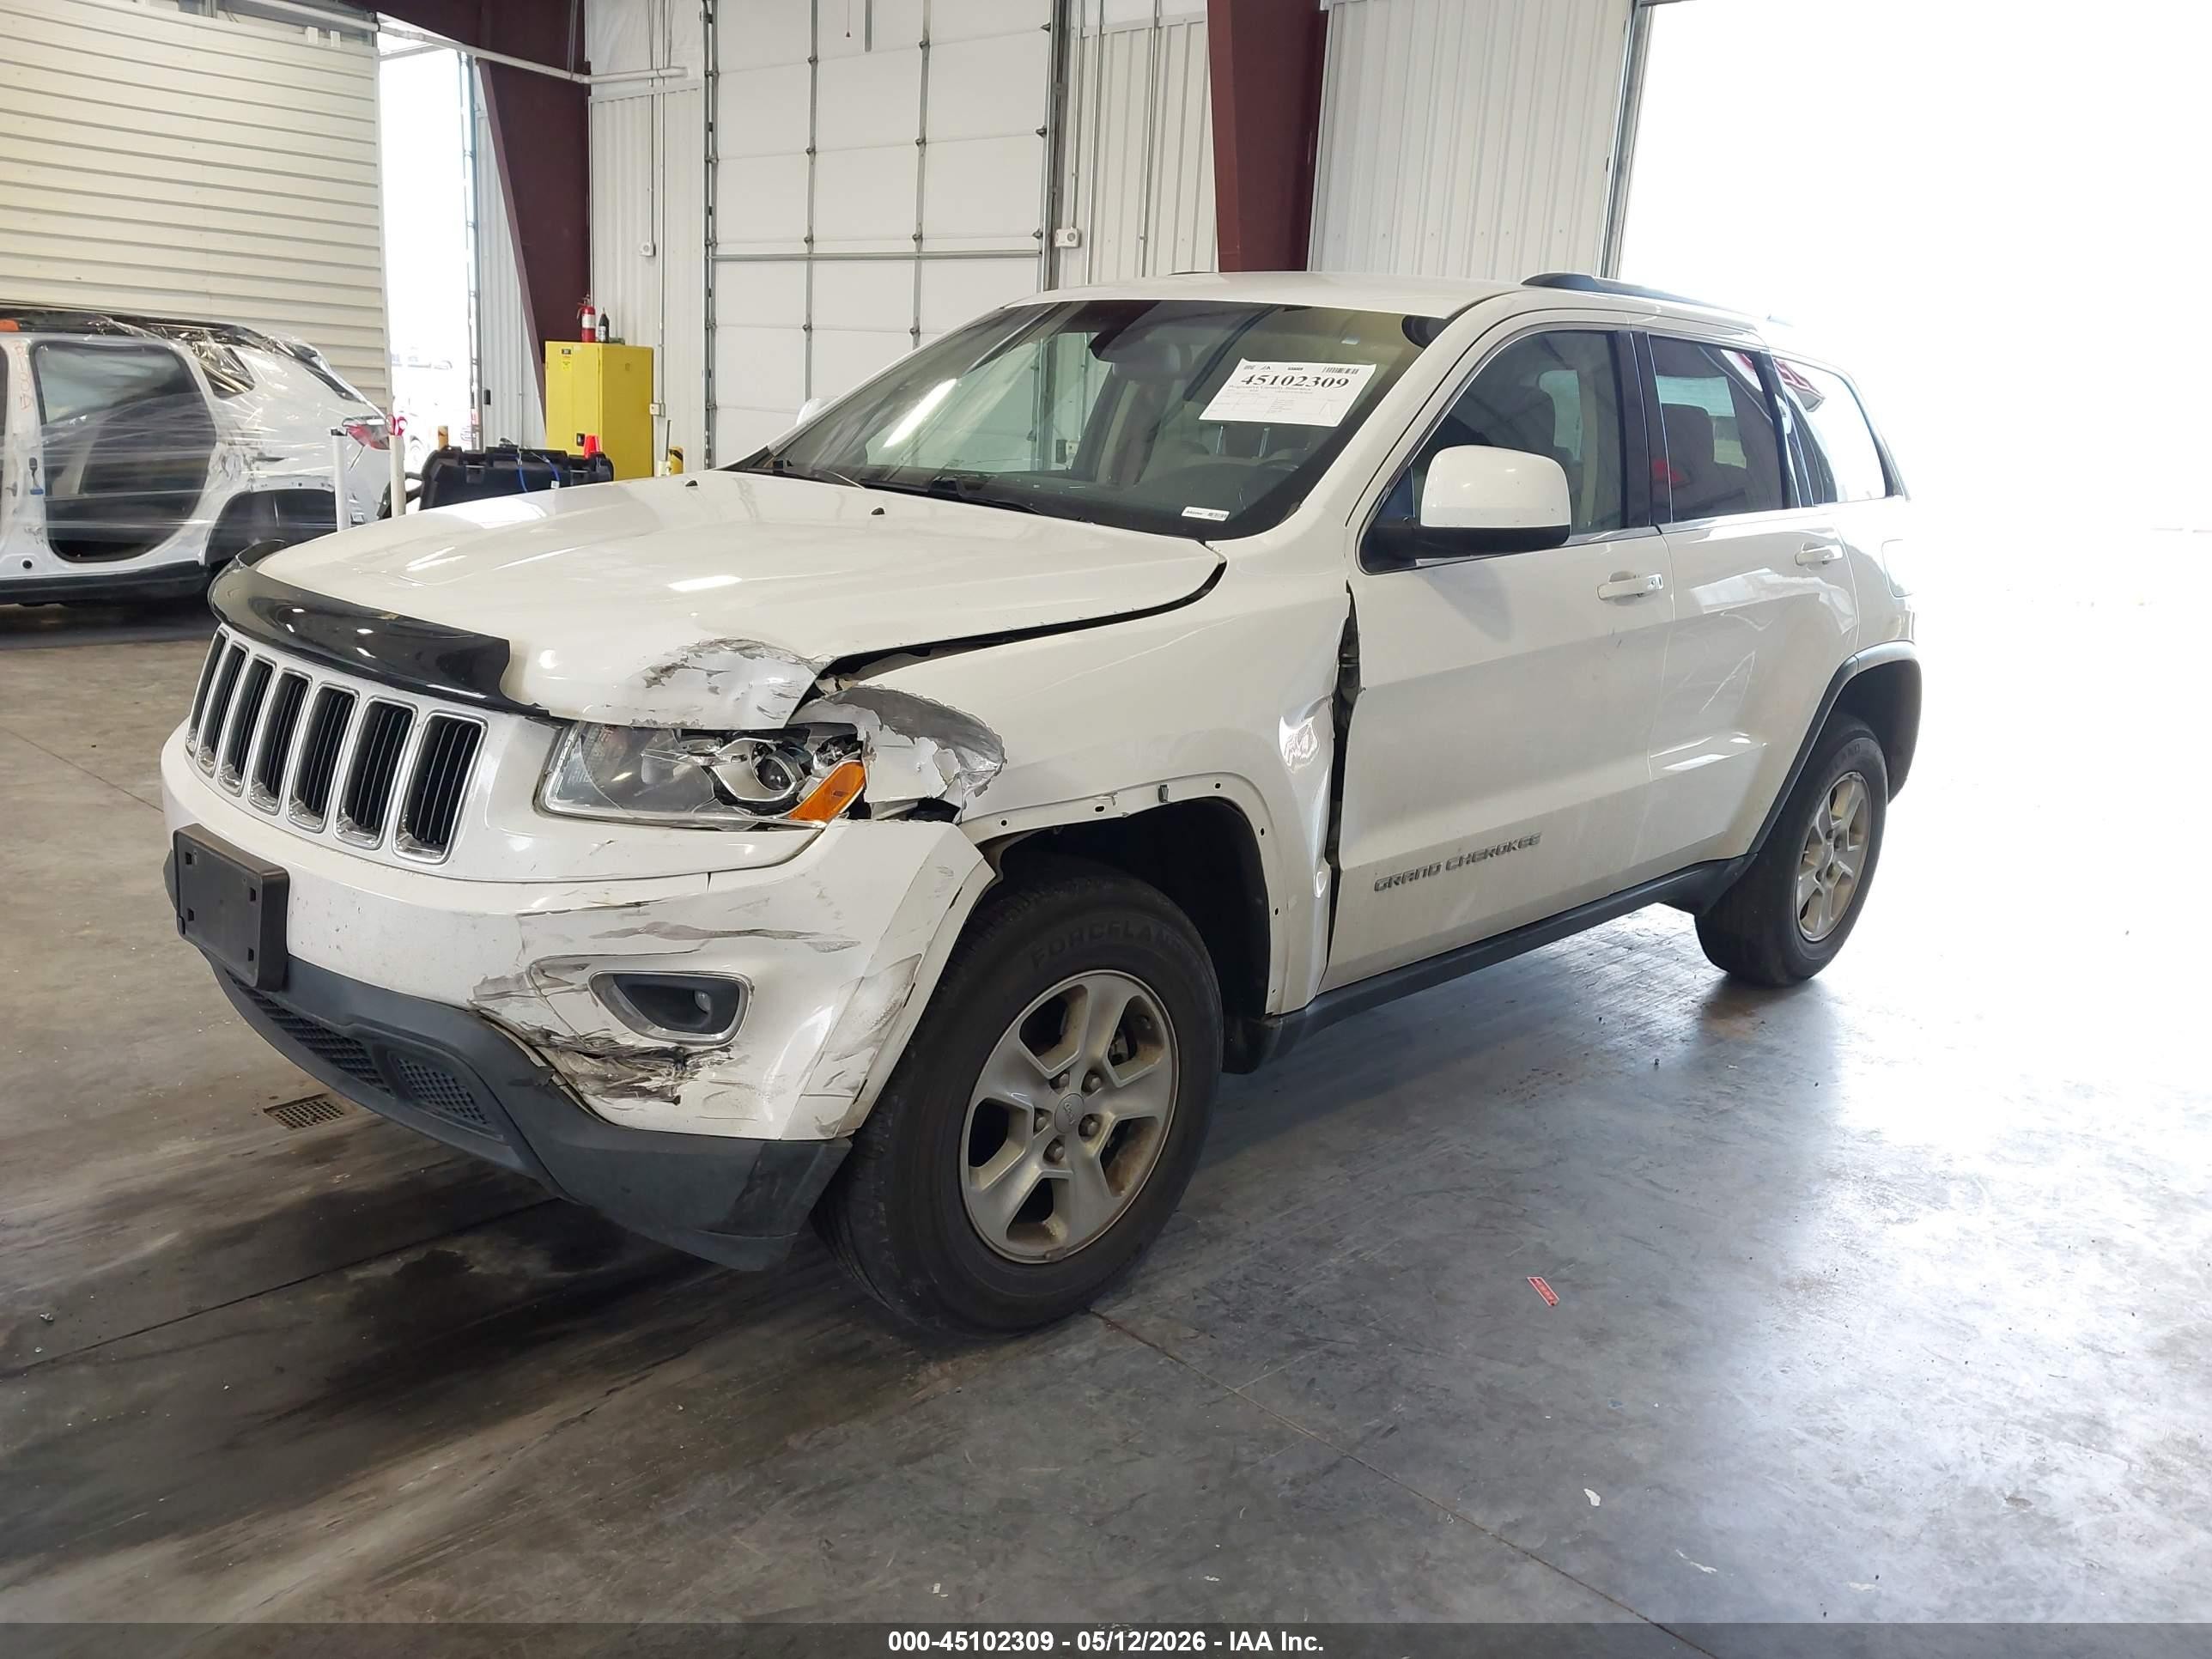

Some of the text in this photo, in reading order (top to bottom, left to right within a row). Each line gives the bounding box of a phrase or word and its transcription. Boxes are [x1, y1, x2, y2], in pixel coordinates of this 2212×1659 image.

[1241, 374, 1350, 389] 45102309
[1374, 831, 1543, 892] GRAND CHEROKEE
